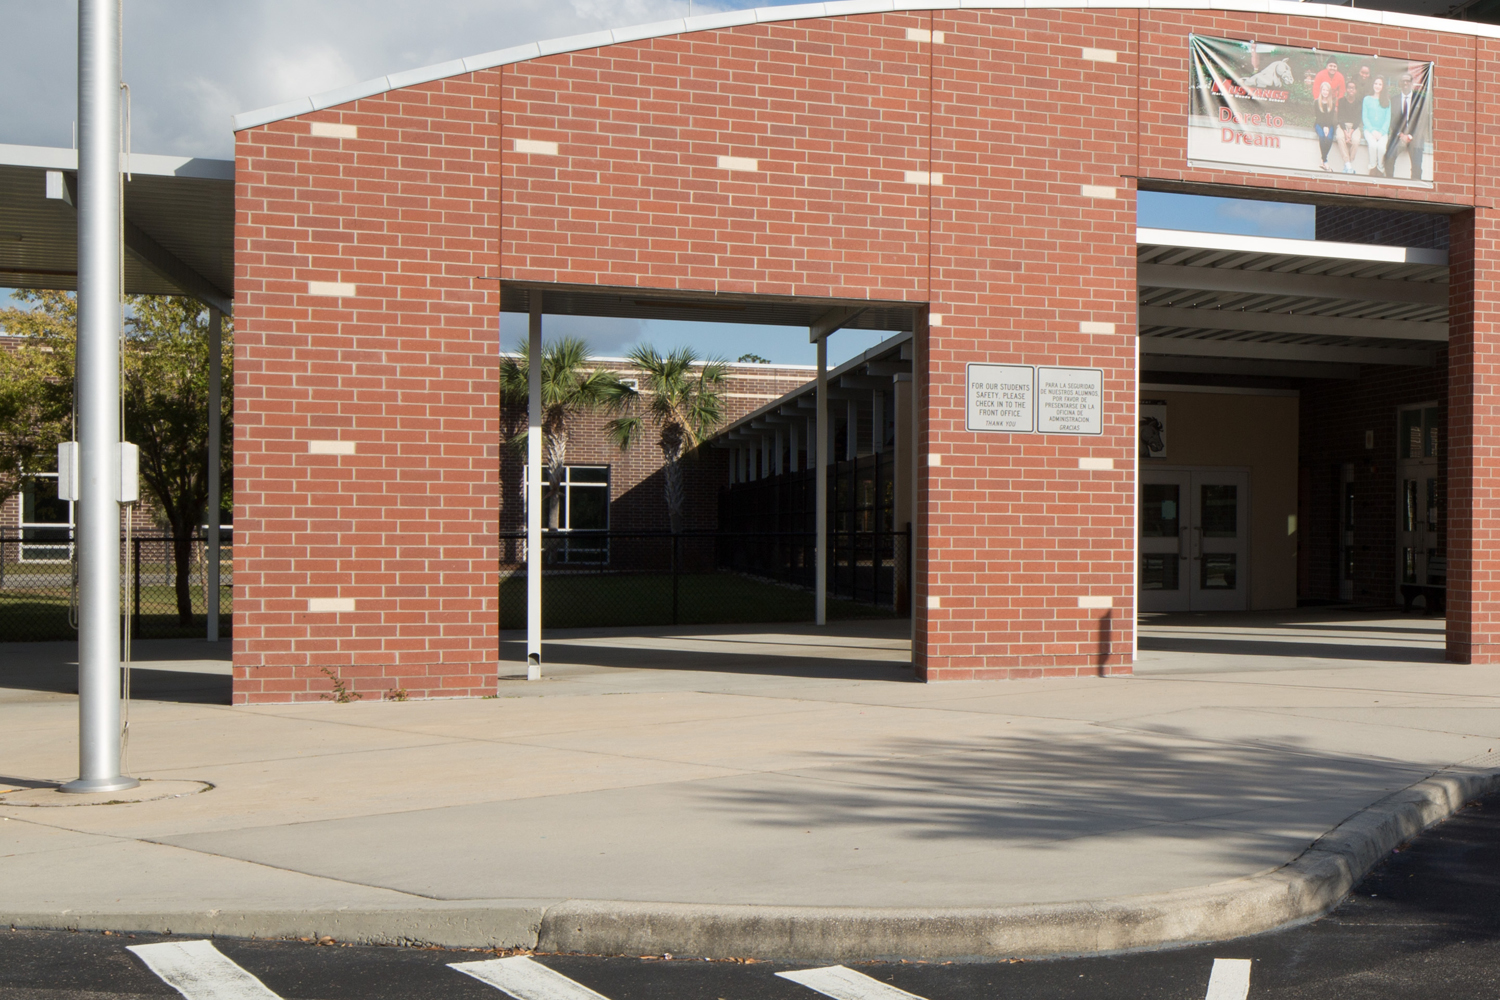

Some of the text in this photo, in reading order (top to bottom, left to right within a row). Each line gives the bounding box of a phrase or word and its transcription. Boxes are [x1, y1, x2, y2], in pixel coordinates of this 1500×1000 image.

[1219, 106, 1284, 128] Dare to
[1222, 127, 1281, 148] Dream
